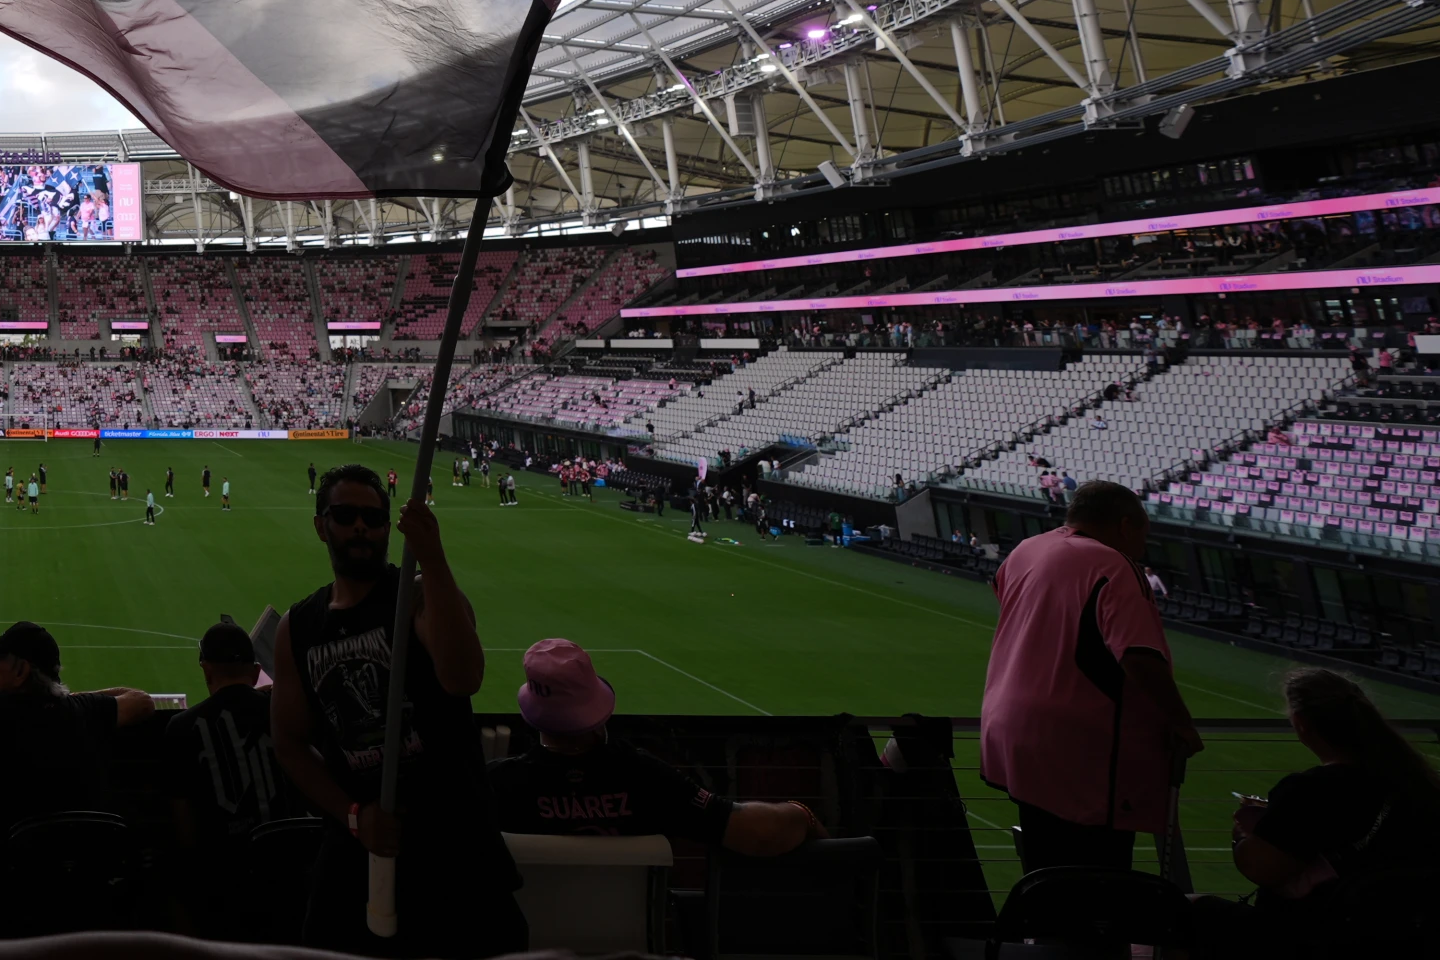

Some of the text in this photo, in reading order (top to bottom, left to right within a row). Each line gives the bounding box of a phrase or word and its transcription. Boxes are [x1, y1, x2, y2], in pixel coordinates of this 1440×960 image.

[1400, 196, 1429, 205] Stadium
[1270, 210, 1293, 218] Stadium
[1373, 275, 1404, 283] Stadium
